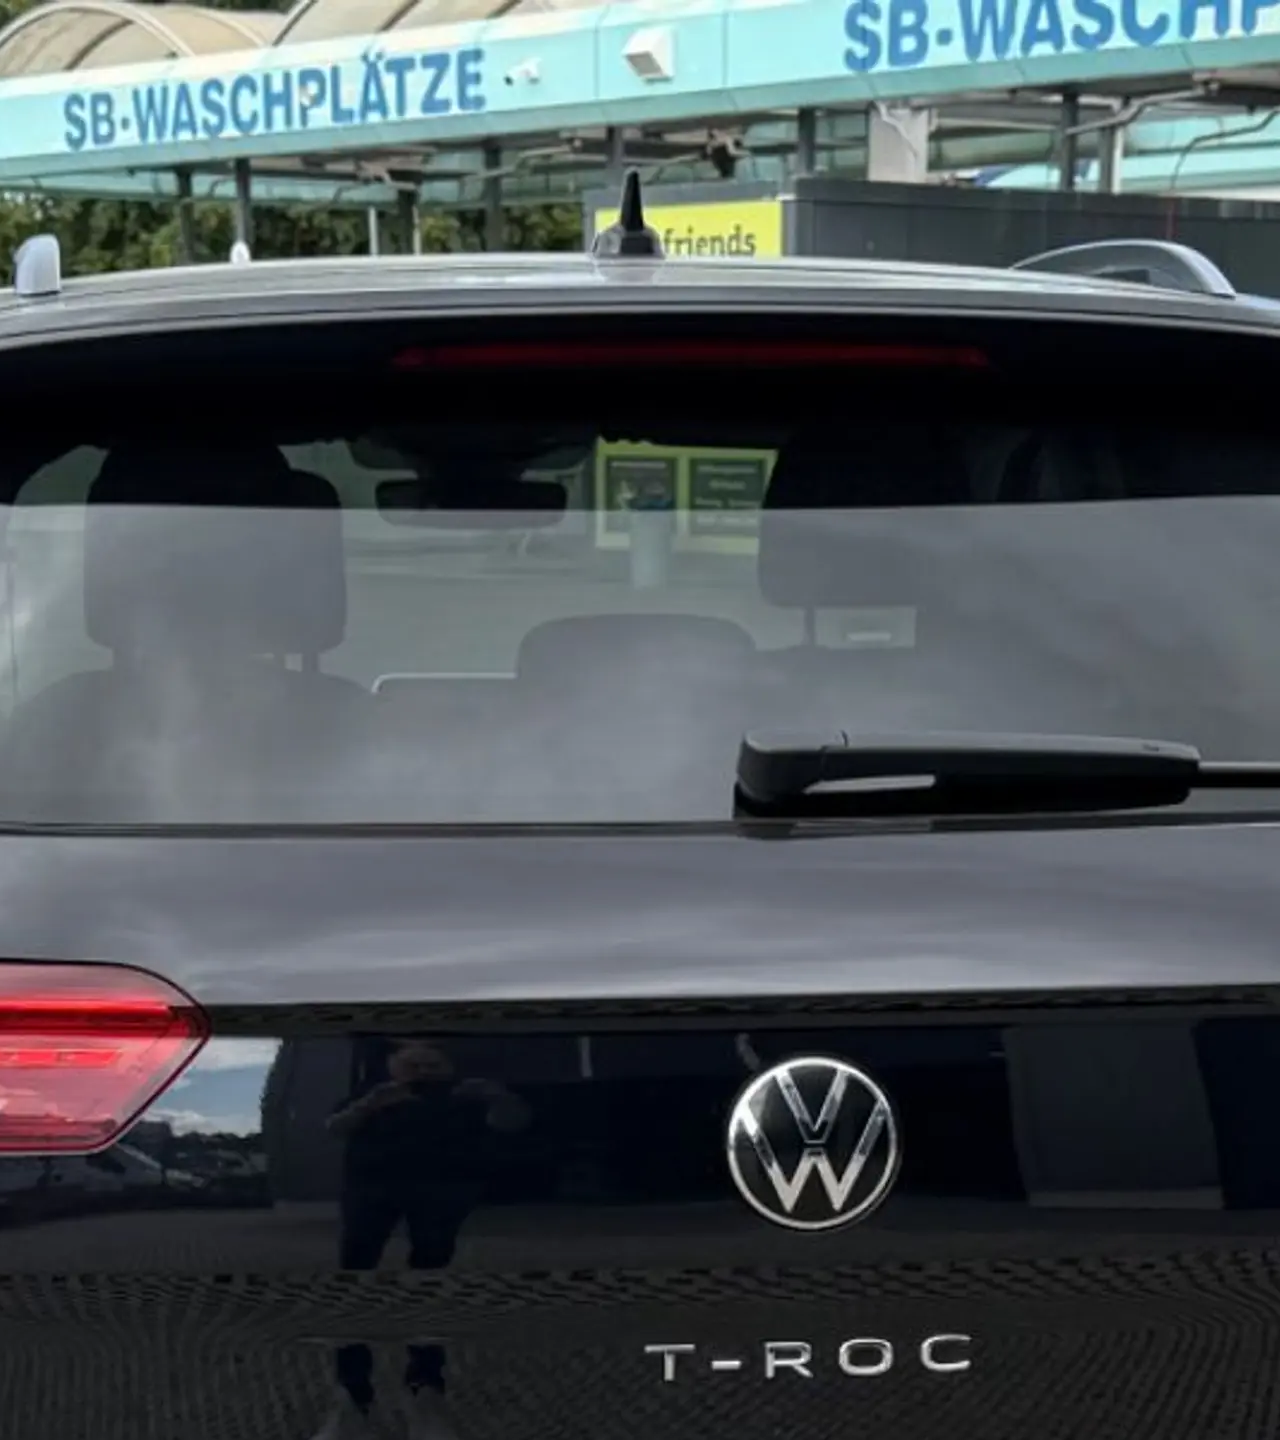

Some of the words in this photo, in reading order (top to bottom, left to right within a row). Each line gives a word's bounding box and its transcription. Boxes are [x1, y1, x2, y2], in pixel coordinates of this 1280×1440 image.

[64, 48, 486, 151] SB-WASCHPLÄTZE
[663, 223, 757, 257] friends
[732, 1060, 893, 1212] VW
[644, 1333, 972, 1382] T-ROC
